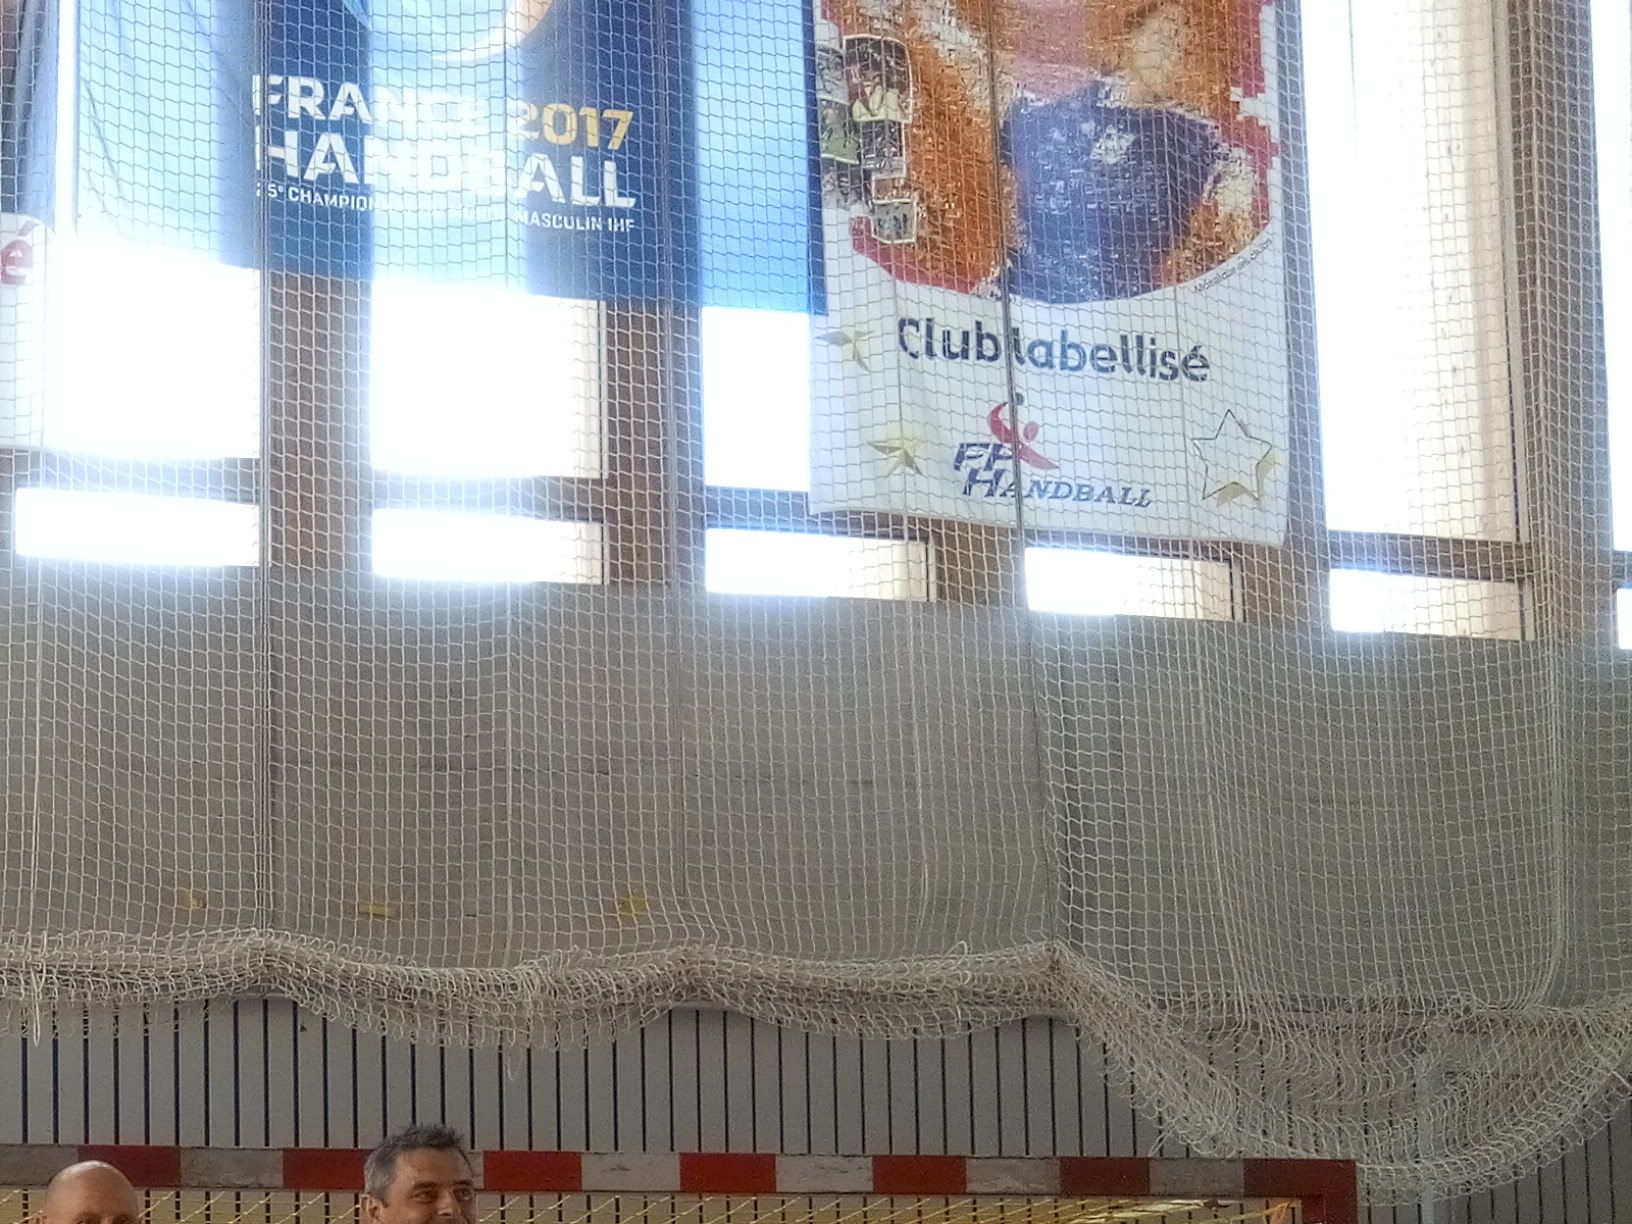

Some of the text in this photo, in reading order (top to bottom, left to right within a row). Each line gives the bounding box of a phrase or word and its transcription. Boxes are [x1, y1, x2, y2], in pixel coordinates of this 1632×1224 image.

[252, 74, 634, 150] FRANCE 2017
[255, 125, 636, 208] HANDBALL
[898, 316, 1210, 382] Club labellisé
[962, 468, 1152, 507] HANDBALL
